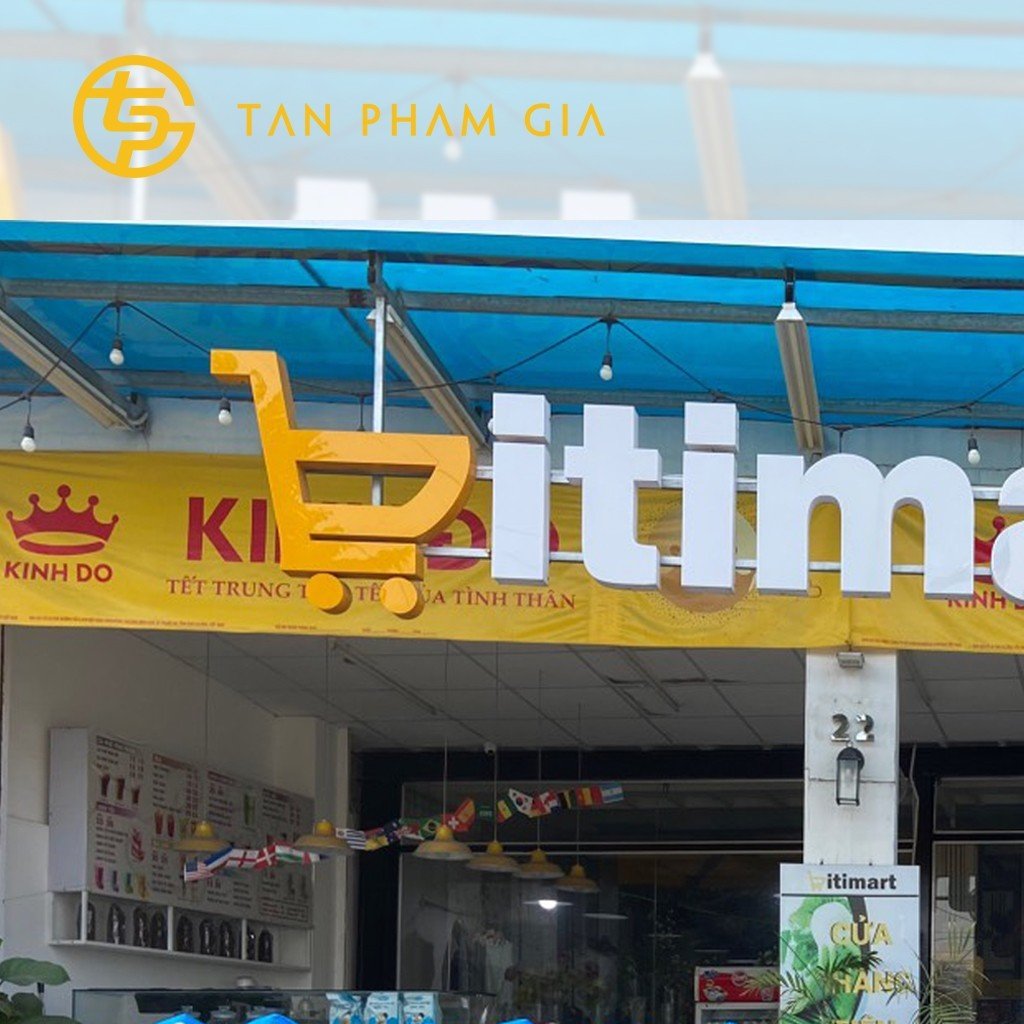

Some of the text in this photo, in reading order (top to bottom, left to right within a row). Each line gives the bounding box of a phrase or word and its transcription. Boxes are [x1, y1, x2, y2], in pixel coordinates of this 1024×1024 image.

[4, 560, 113, 584] KINH DO
[166, 575, 207, 595] TẾT
[212, 580, 290, 599] TRUNG
[453, 586, 507, 606] TÌNH
[514, 589, 576, 609] THÂN
[830, 713, 875, 742] 22
[831, 914, 892, 946] CỬA
